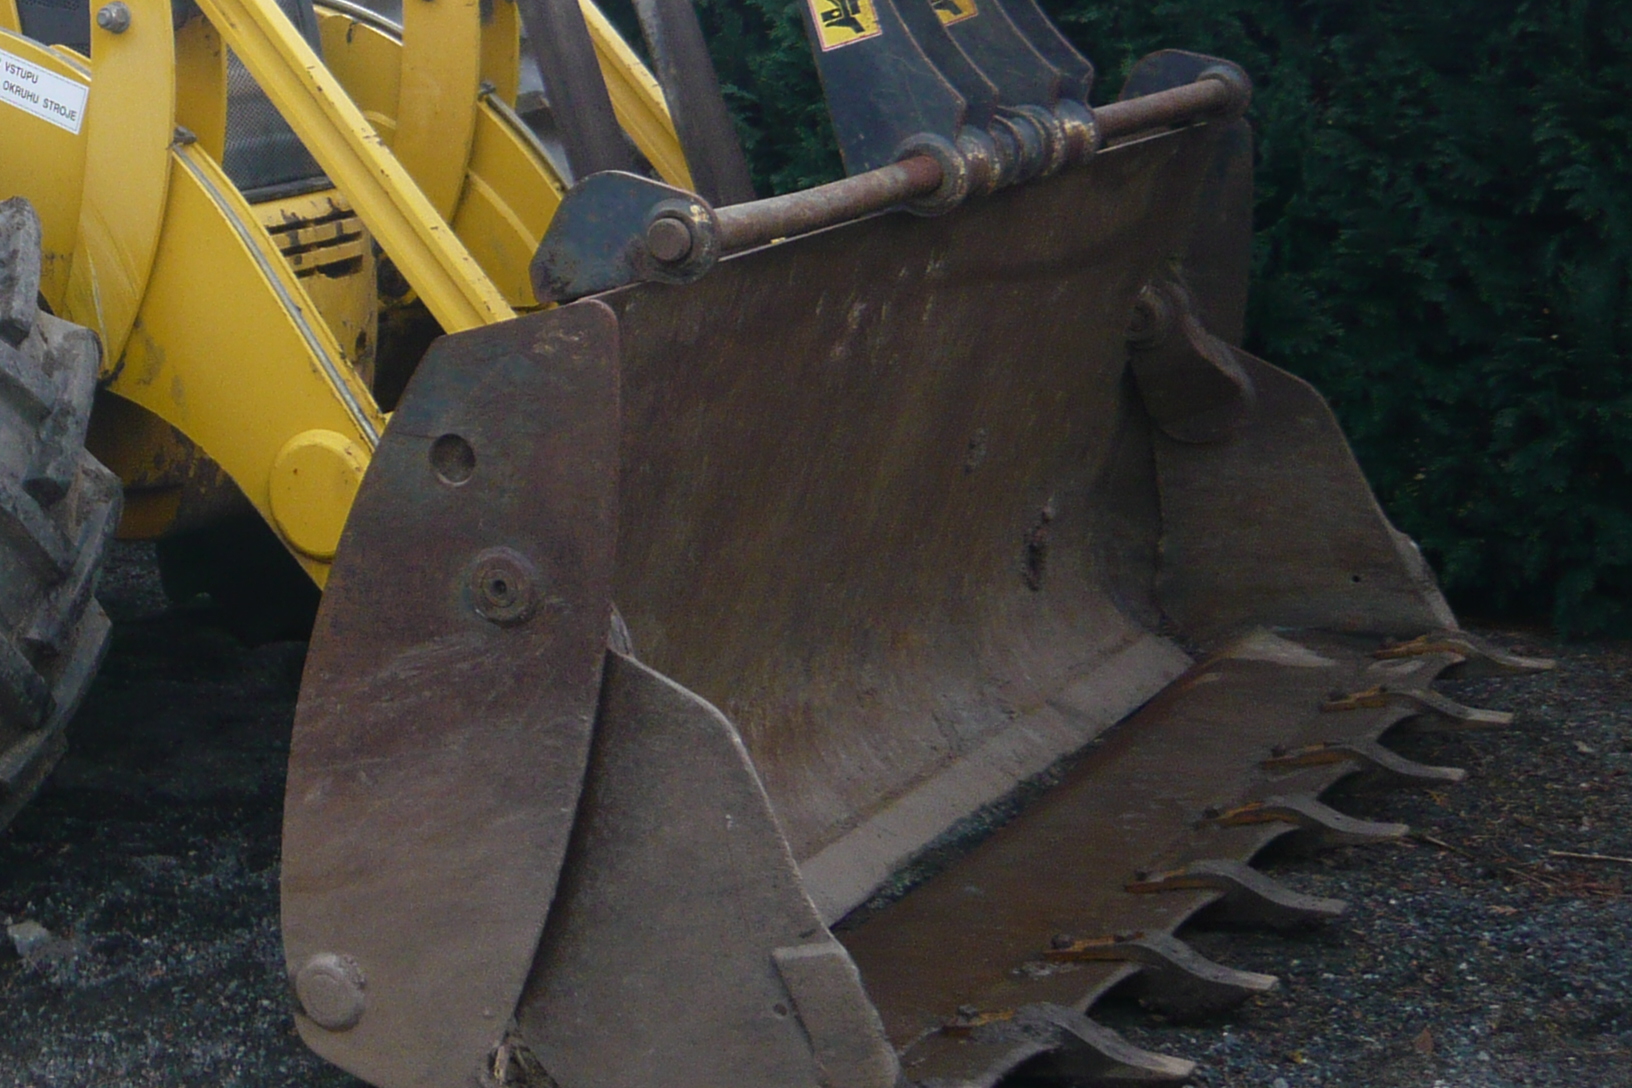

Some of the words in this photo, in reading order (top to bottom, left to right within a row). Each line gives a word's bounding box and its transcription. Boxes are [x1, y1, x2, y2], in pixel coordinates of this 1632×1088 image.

[4, 61, 40, 85] VSTUPU
[2, 80, 40, 105] OKRUHU
[42, 98, 78, 122] STROJE
